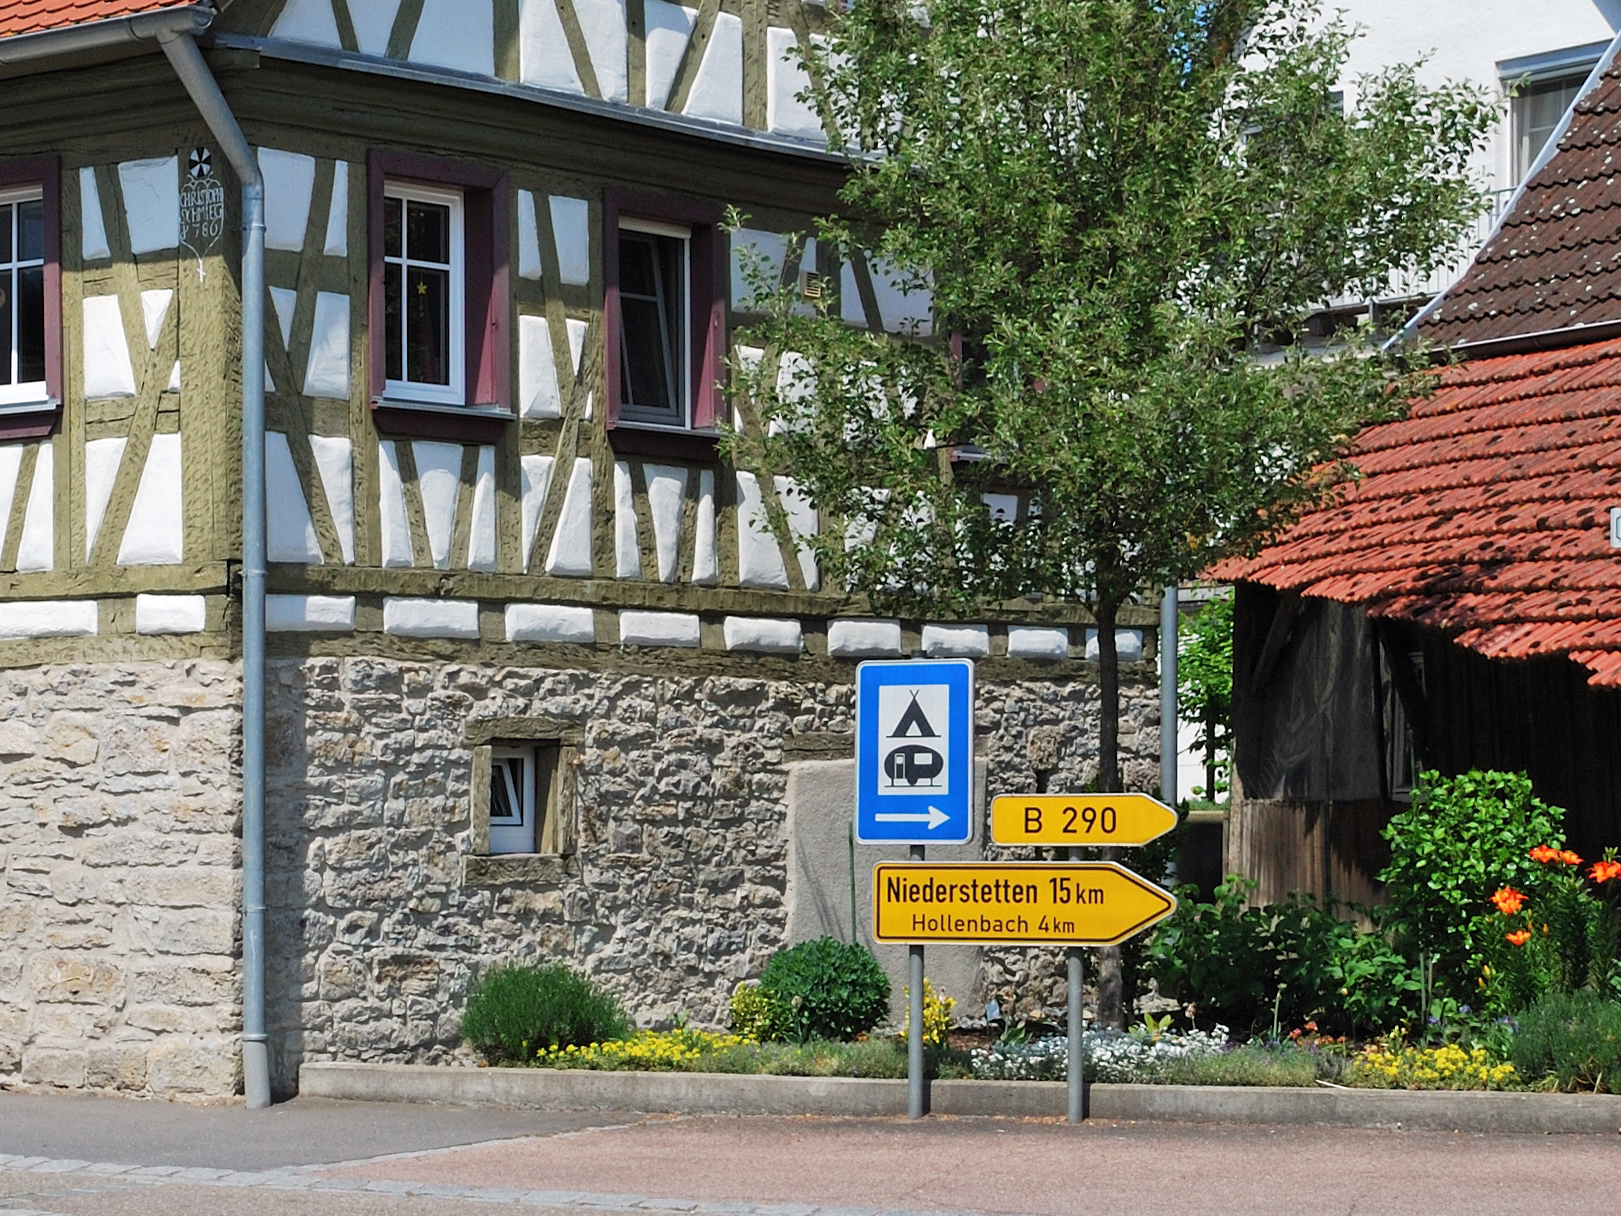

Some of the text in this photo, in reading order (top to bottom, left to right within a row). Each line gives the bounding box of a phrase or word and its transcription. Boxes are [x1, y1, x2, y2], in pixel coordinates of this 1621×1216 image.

[1024, 806, 1117, 834] B 290
[887, 876, 1038, 904] Niederstetten
[912, 914, 1029, 933] Hollenbach
